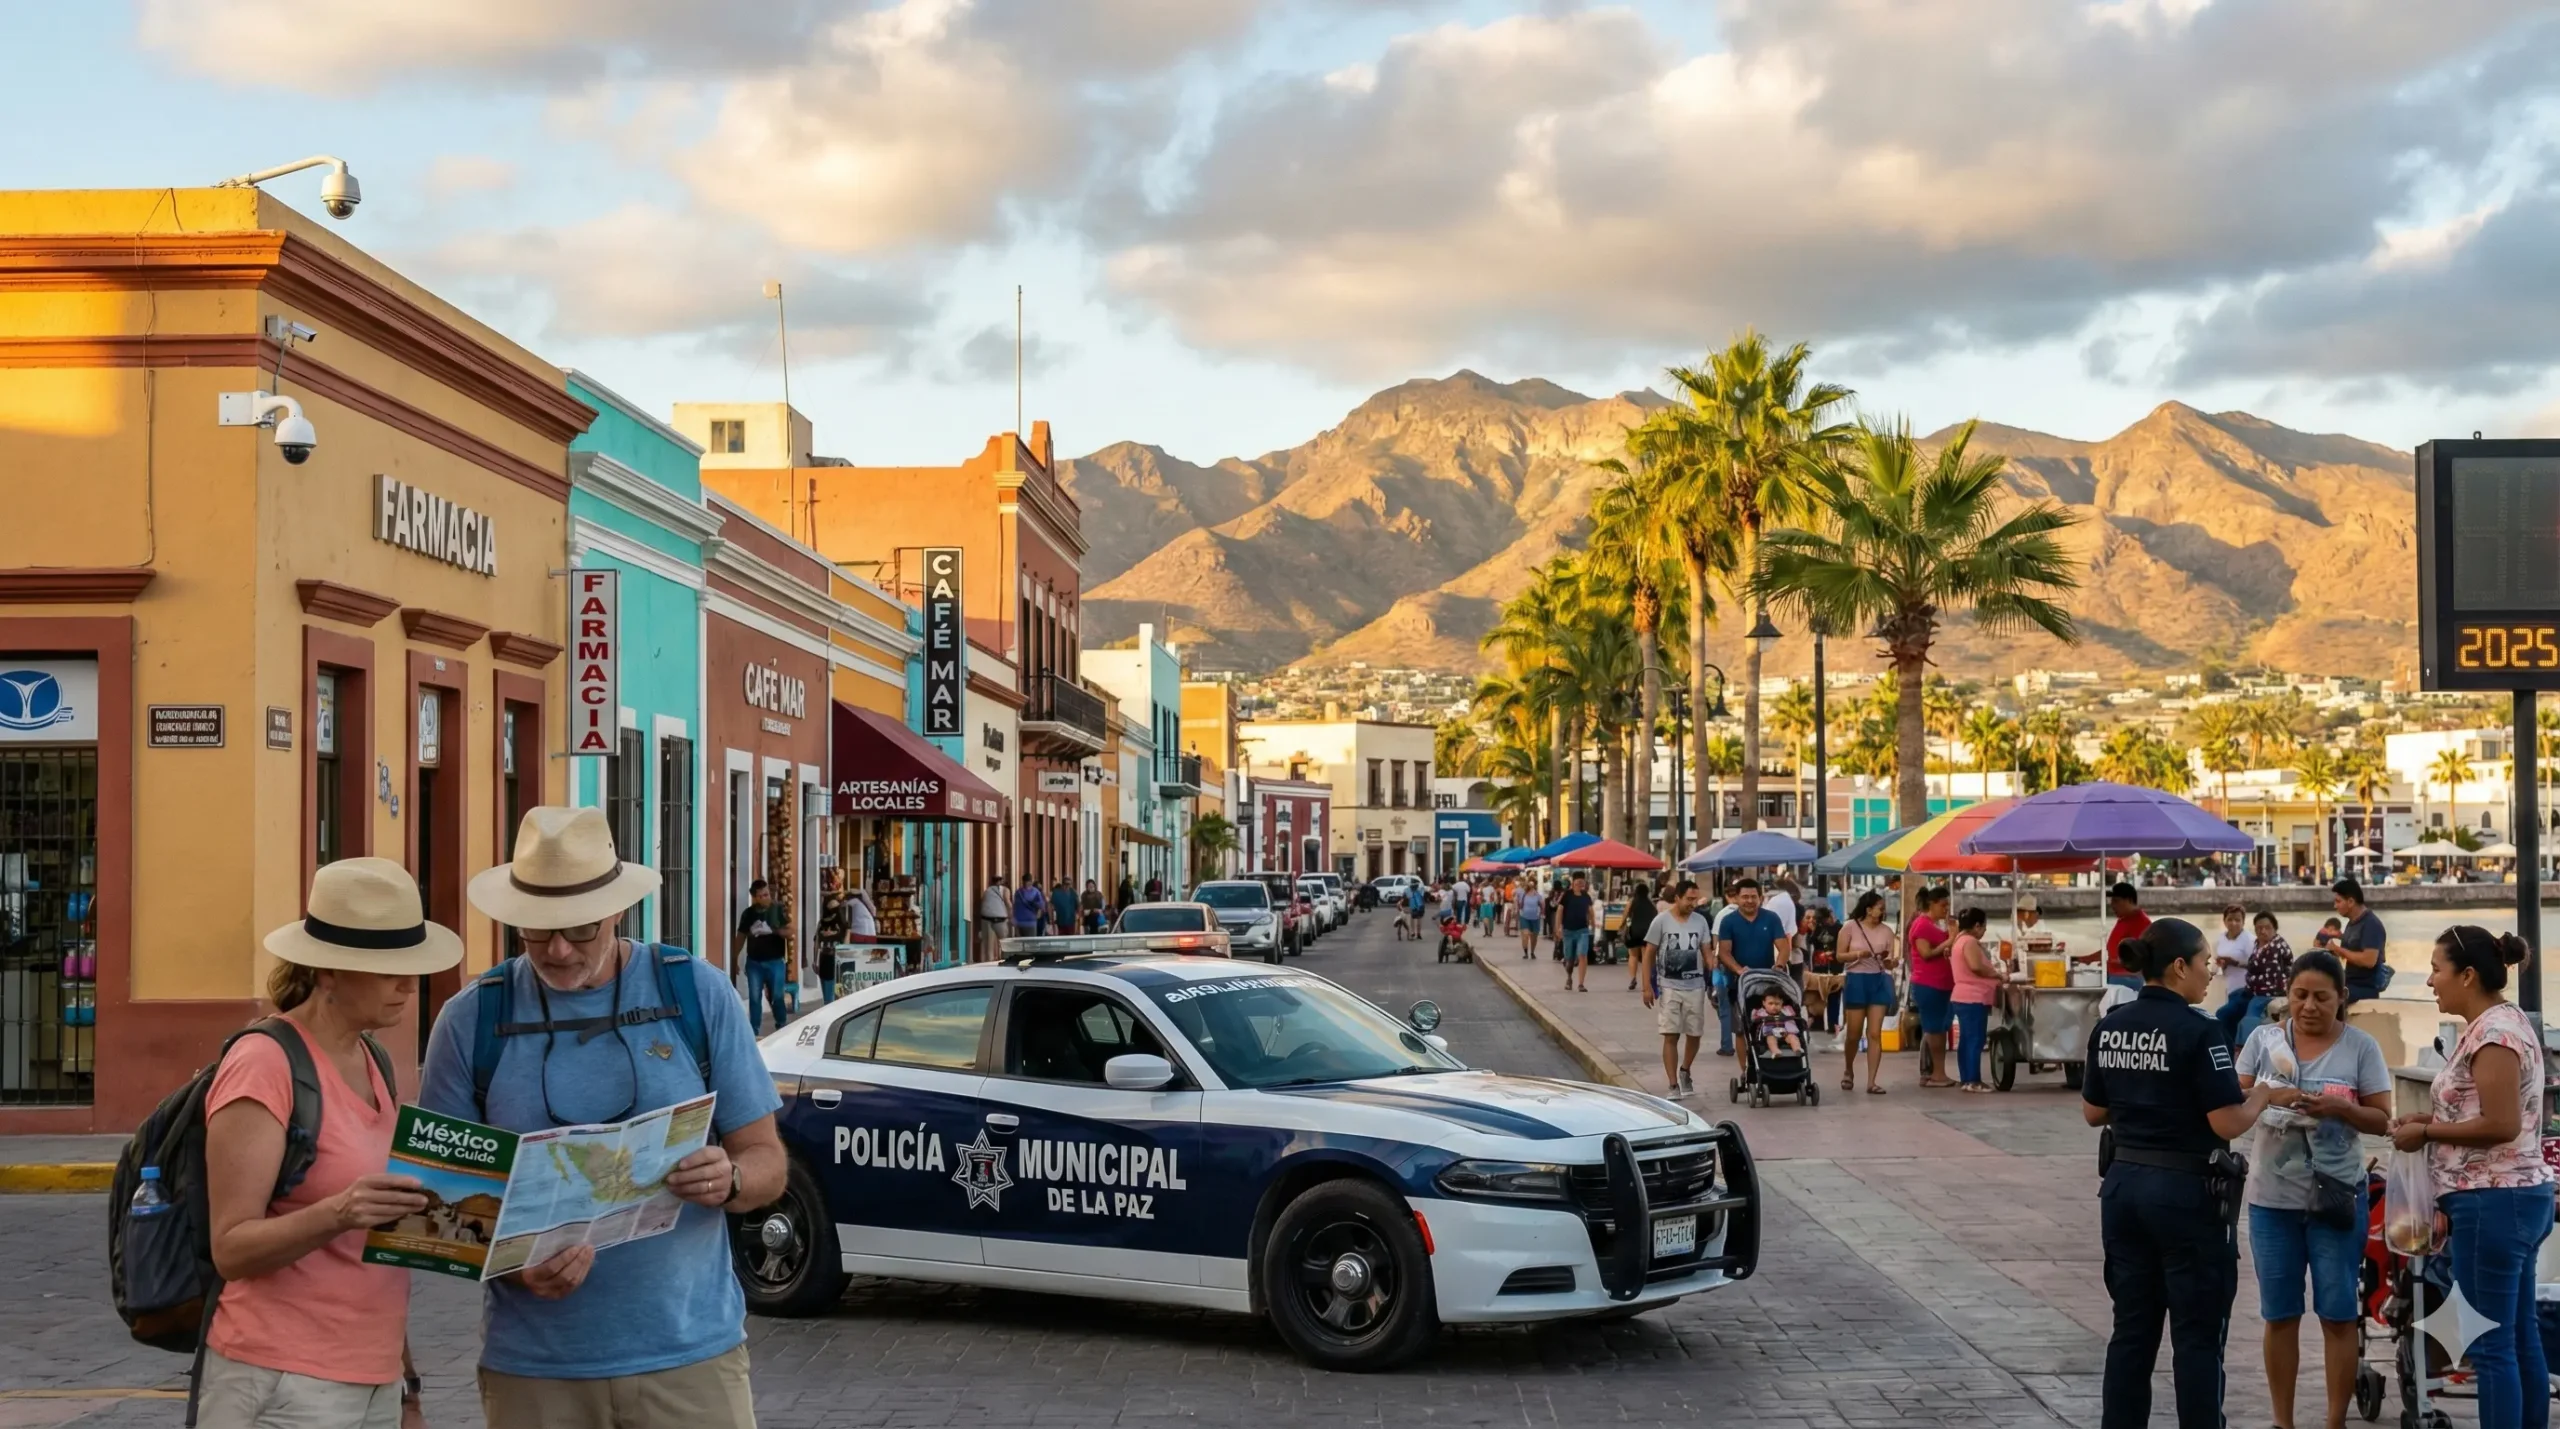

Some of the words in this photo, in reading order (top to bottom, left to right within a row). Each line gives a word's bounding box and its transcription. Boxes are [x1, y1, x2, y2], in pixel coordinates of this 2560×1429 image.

[378, 474, 498, 577] FARMACIA
[932, 554, 953, 649] CAFÉ
[578, 574, 609, 750] FARMACIA
[2460, 627, 2558, 668] 2025
[744, 657, 778, 712] CAFÉ
[779, 674, 806, 719] MAR
[931, 660, 954, 728] MAR
[838, 778, 939, 795] ARTESANÍAS
[852, 796, 926, 811] LOCALES
[2099, 1028, 2168, 1053] POLICÍA
[2098, 1050, 2170, 1072] MUNICIPAL
[407, 1136, 452, 1157] Safety
[411, 1117, 499, 1152] México
[834, 1122, 946, 1173] POLICÍA
[1018, 1138, 1187, 1191] MUNICIPAL
[1048, 1188, 1076, 1213] DE
[1081, 1190, 1109, 1215] LA
[1114, 1193, 1155, 1220] PAZ
